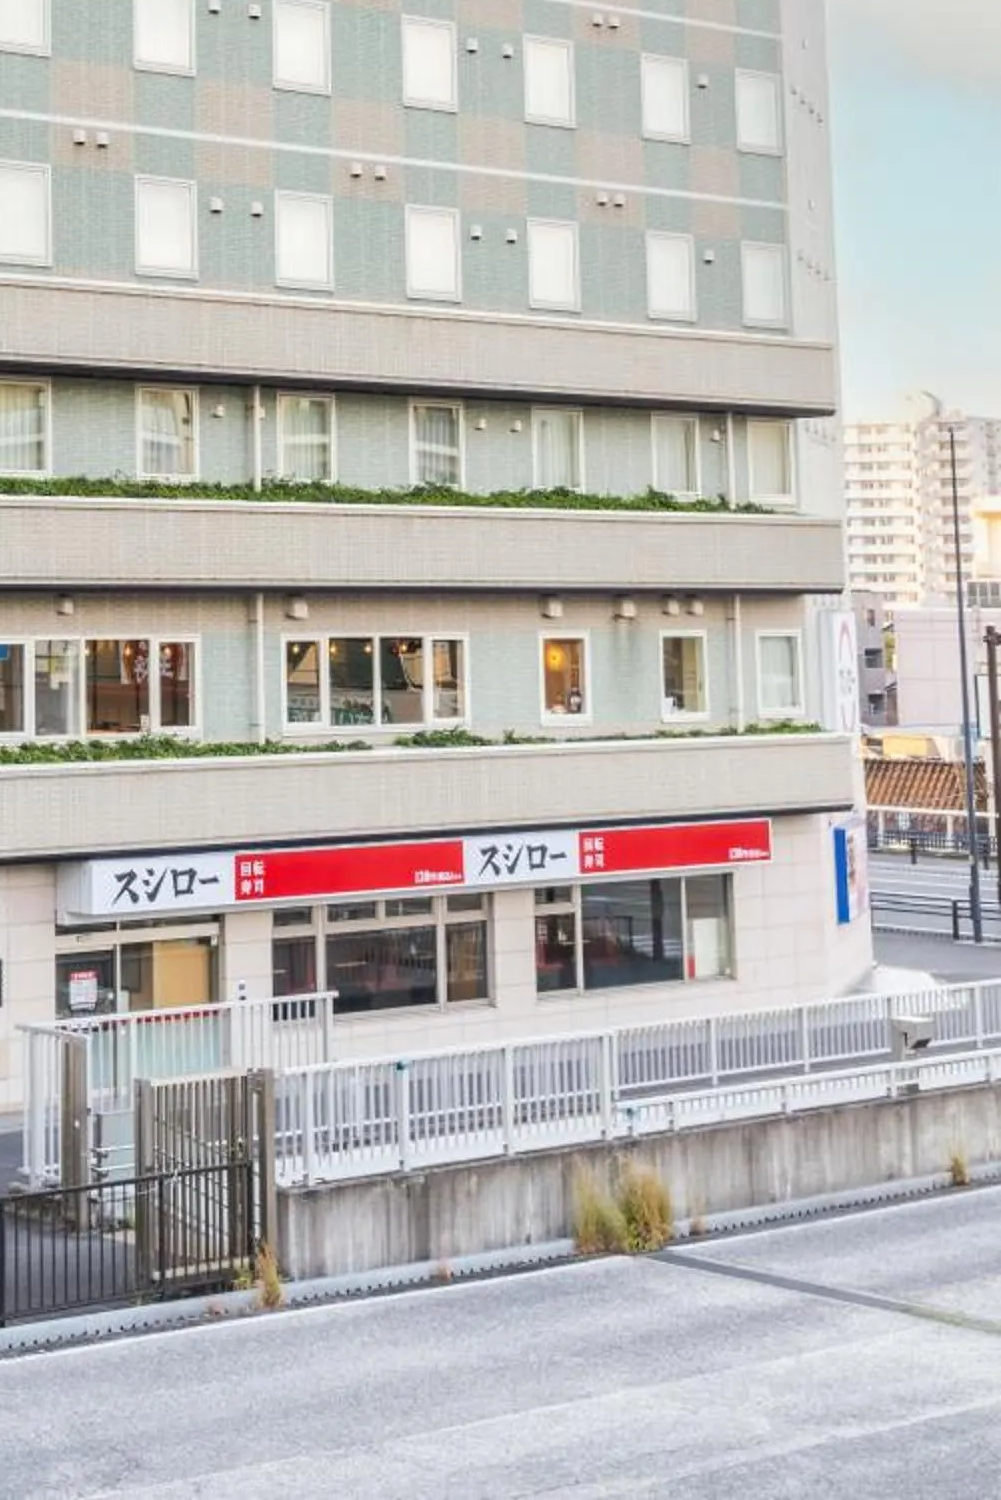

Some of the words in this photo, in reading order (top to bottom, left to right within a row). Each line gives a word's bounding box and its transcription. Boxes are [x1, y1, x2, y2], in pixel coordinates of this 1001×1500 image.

[479, 842, 567, 877] スシロー
[111, 866, 220, 906] スシロー
